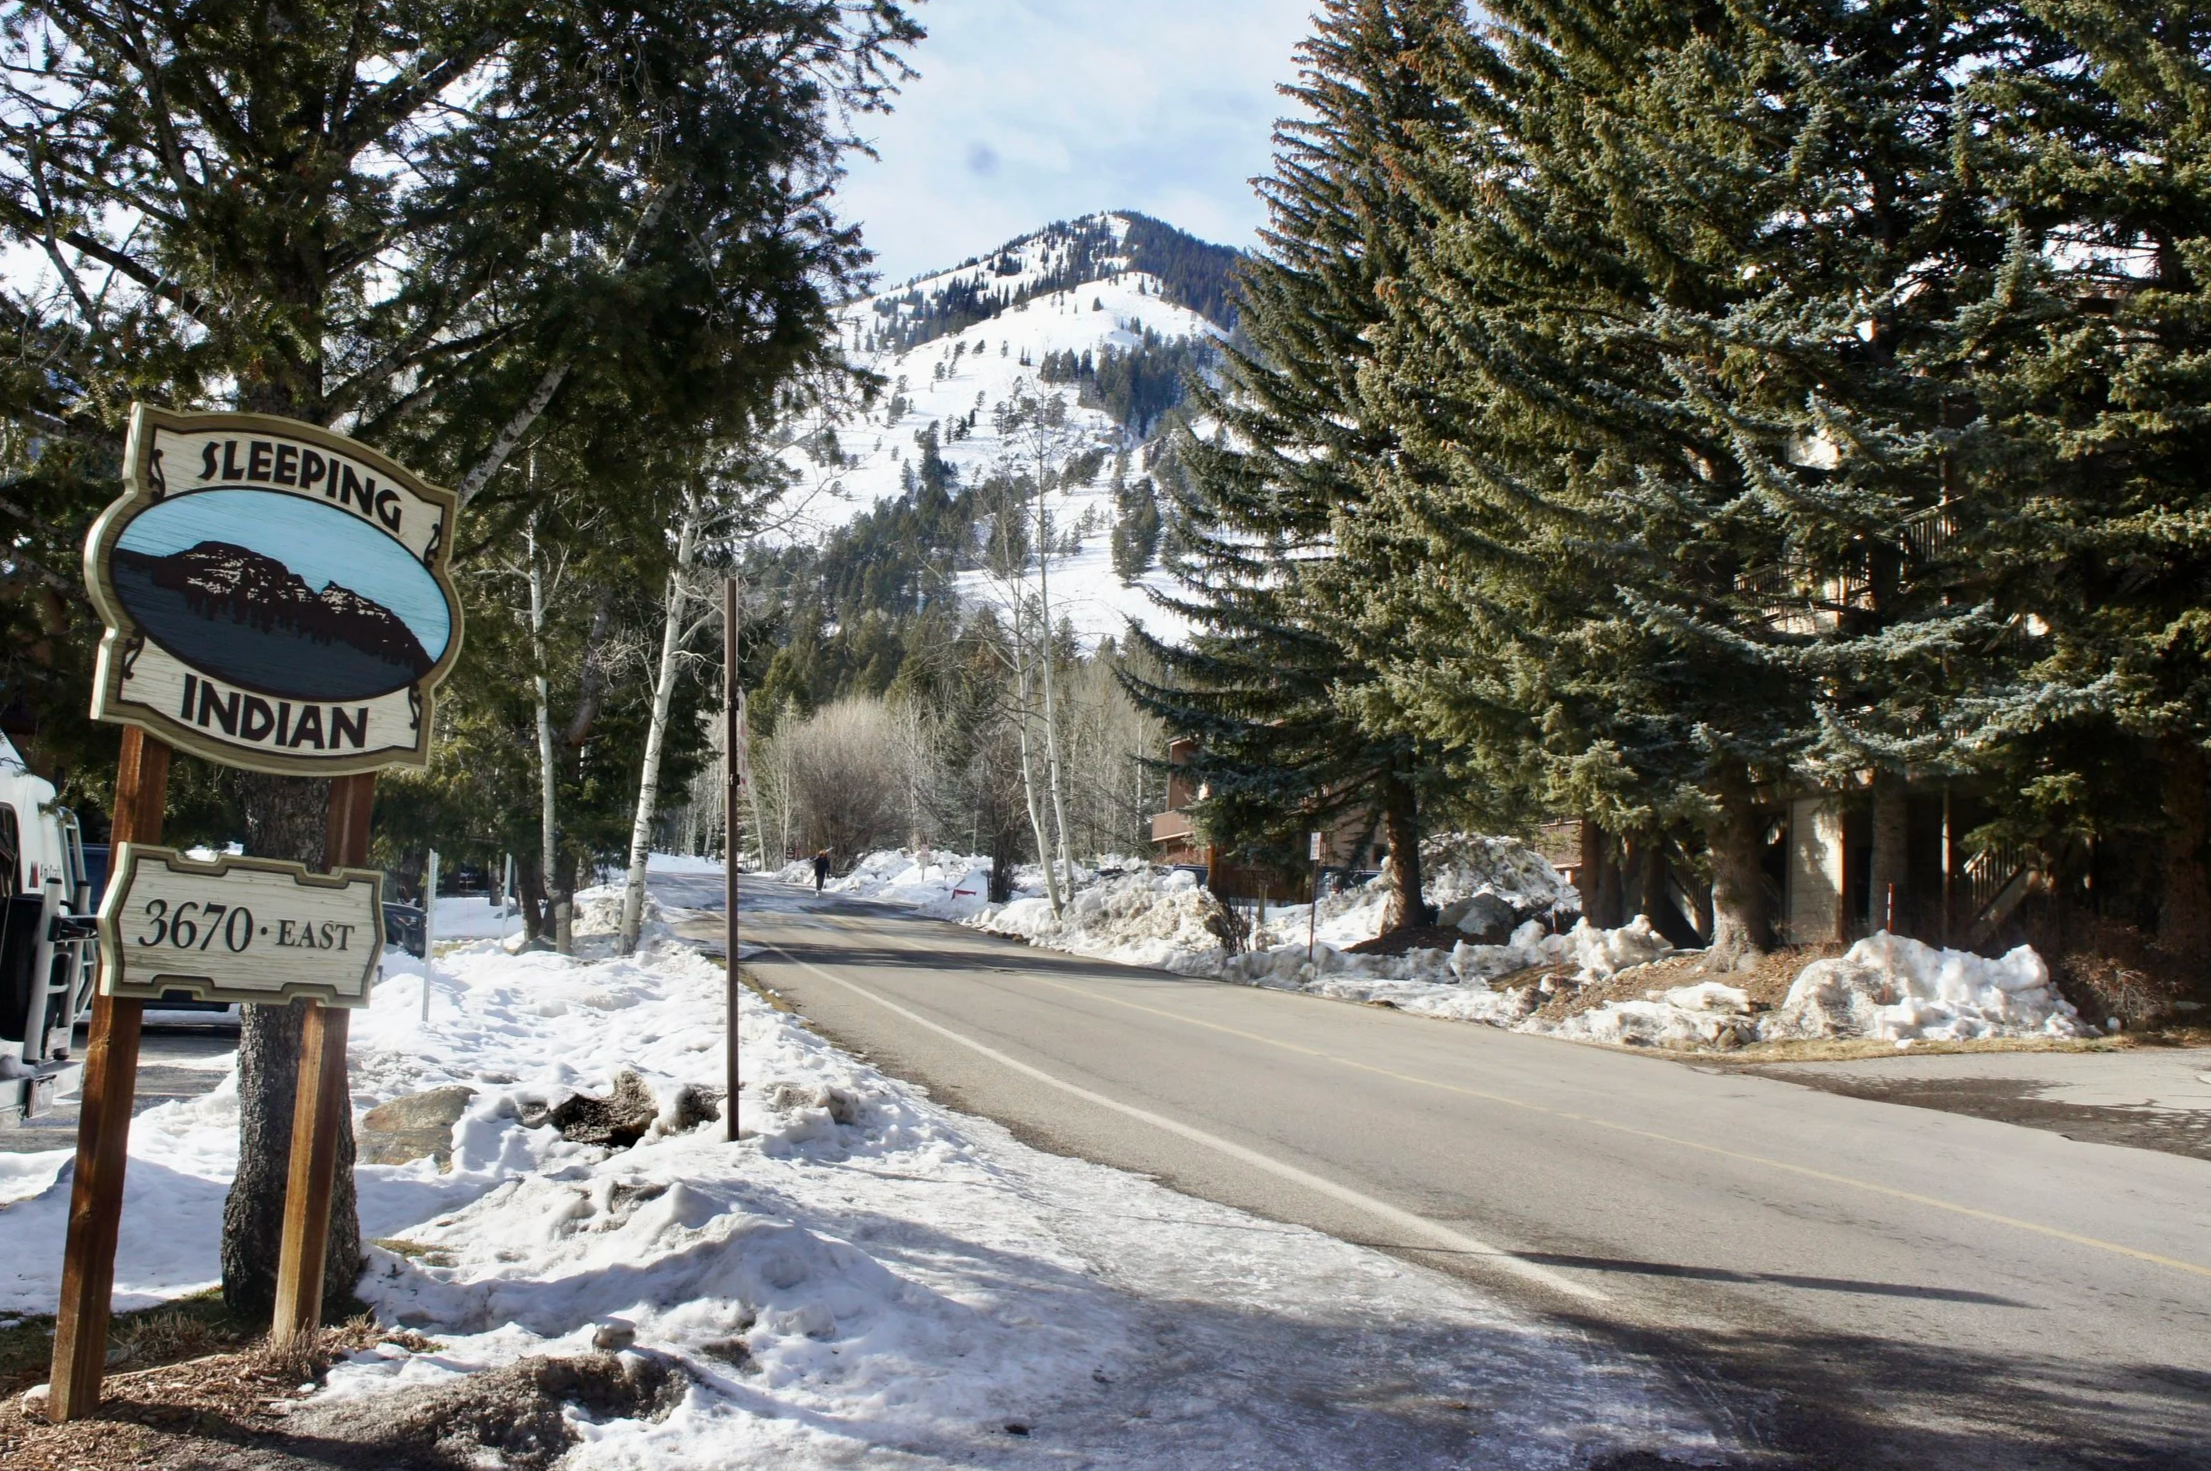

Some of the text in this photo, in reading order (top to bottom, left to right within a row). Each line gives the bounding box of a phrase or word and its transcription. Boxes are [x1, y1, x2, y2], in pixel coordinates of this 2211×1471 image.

[197, 440, 403, 534] SLEEPING
[180, 672, 369, 750] INDIAN
[138, 899, 355, 953] 3670 EAST
